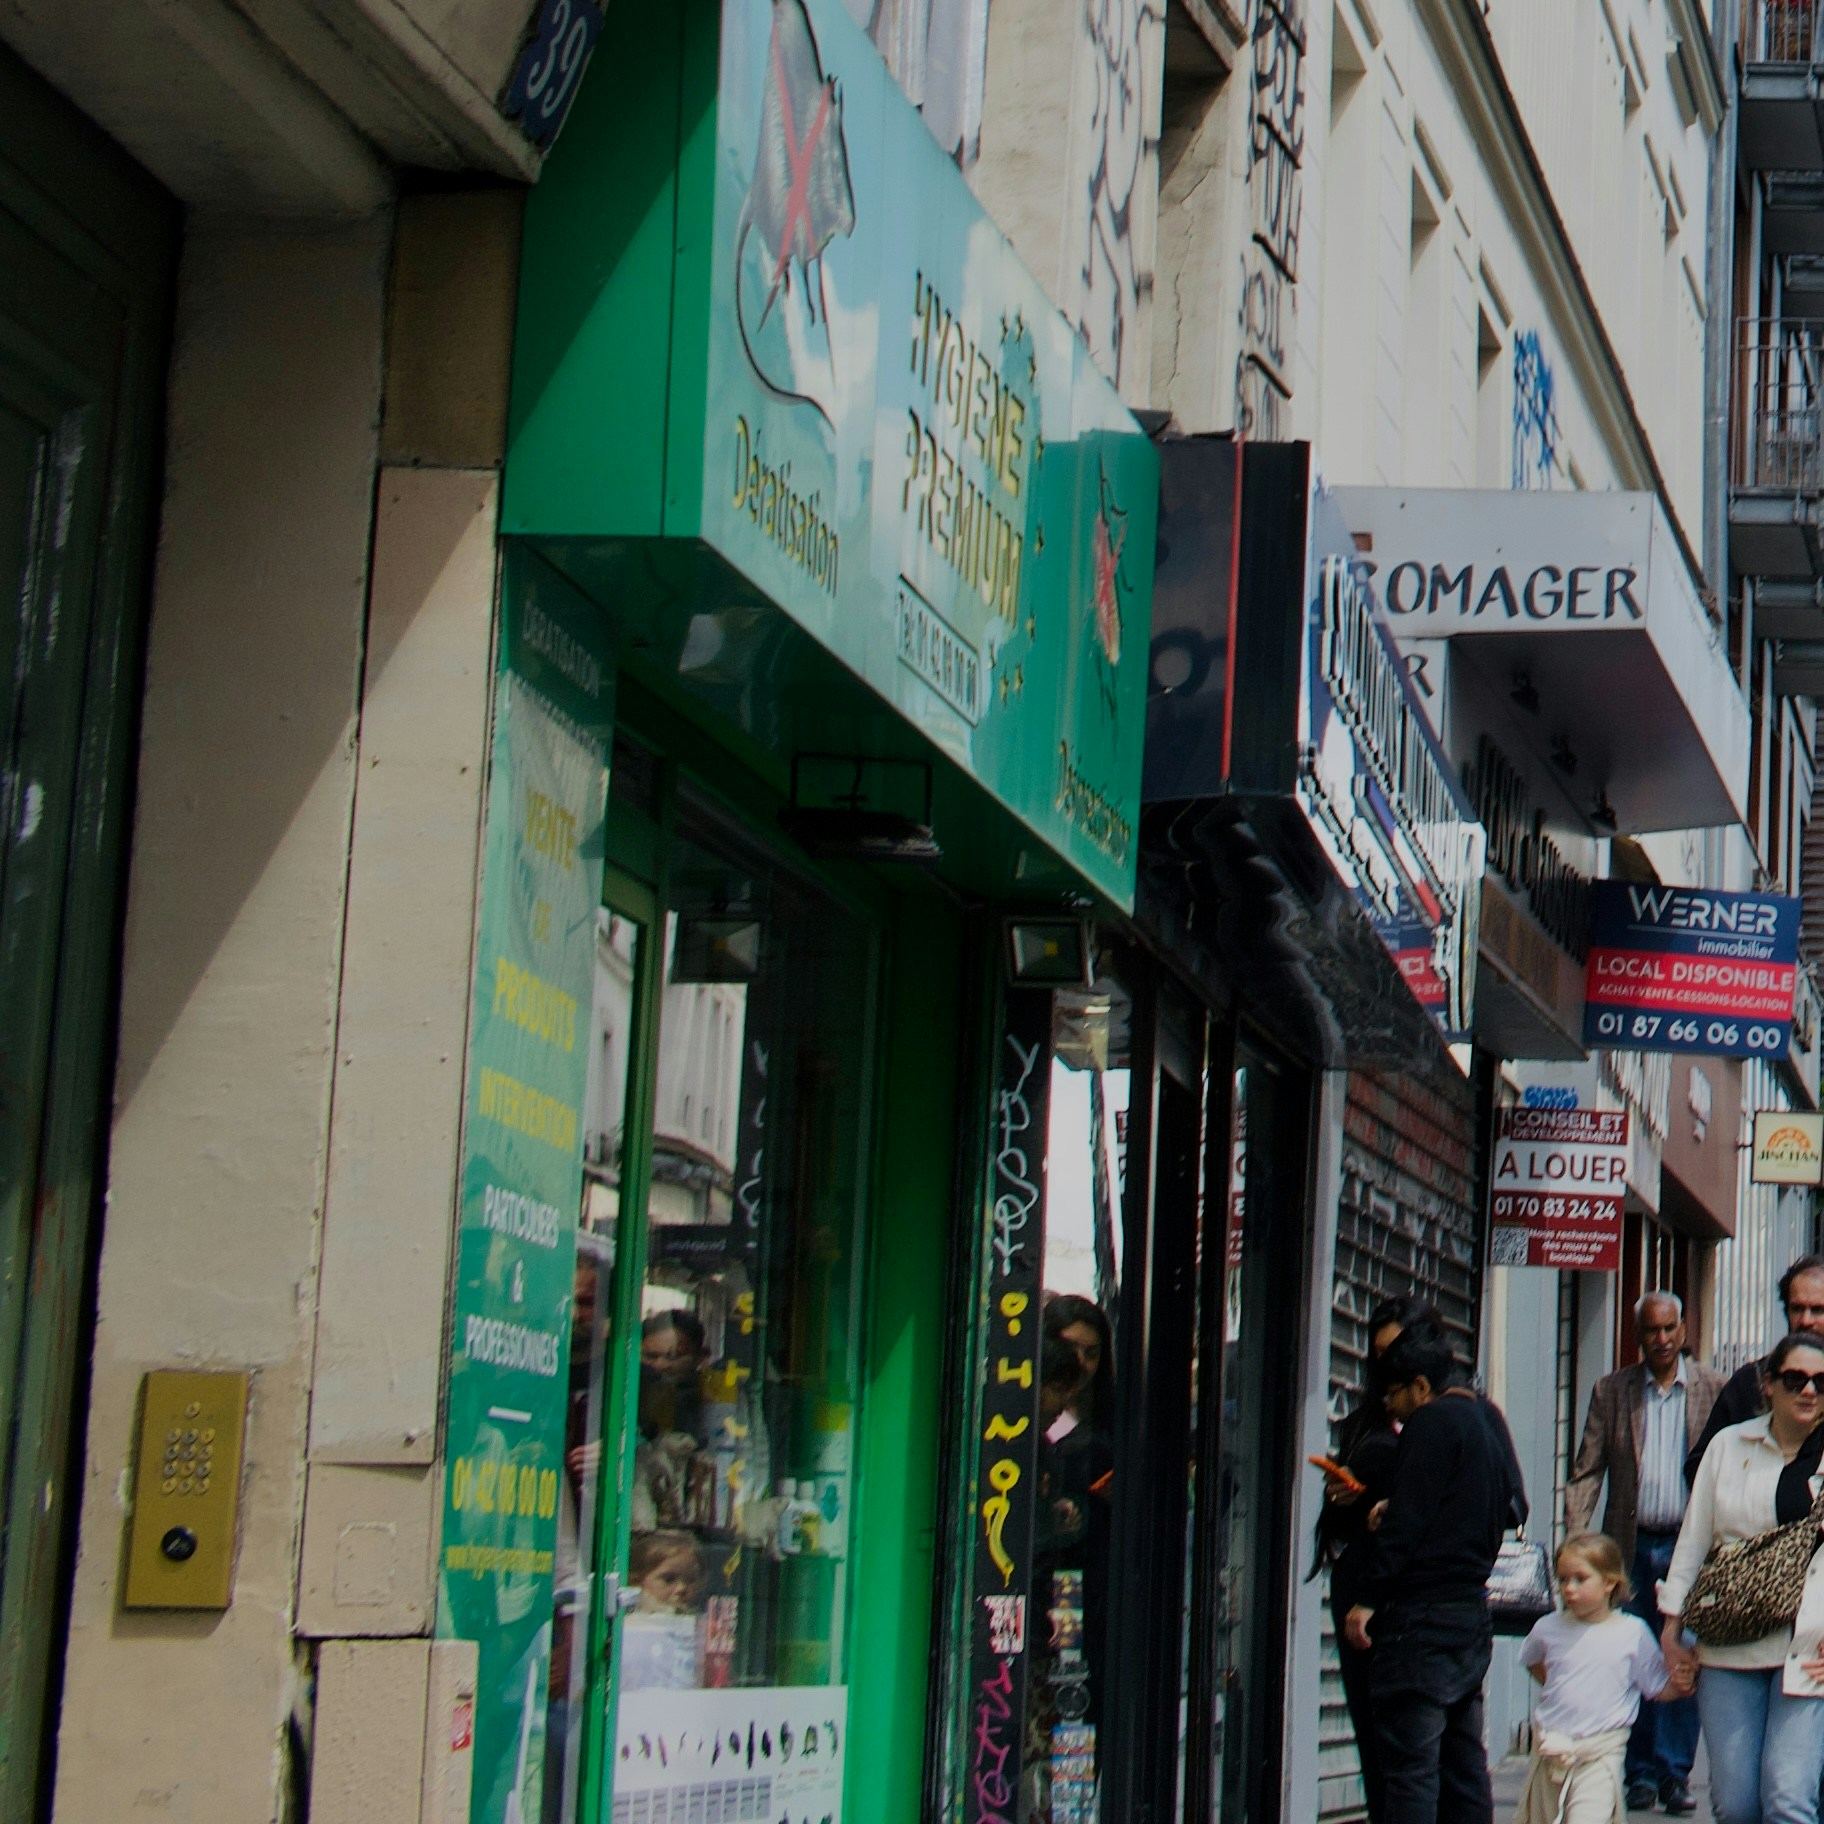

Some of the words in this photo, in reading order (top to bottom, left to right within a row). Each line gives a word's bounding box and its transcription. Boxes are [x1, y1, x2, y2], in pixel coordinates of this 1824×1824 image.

[911, 268, 1024, 498] HYGIENE
[903, 405, 1023, 631] PREMIUM
[526, 784, 577, 871] VENTE
[1628, 885, 1778, 935] WERNER
[1597, 955, 1666, 981] LOCAL
[1672, 962, 1795, 993] DISPONIBLE
[1698, 936, 1775, 960] immobilier
[494, 955, 577, 1053] PRODUITS
[1598, 1012, 1624, 1036] 01
[1632, 1015, 1662, 1039] 87
[1668, 1018, 1699, 1043] 66
[1706, 1021, 1739, 1047] 06
[1747, 1025, 1782, 1050] 00
[479, 1065, 577, 1155] INTERVENTION
[1512, 1126, 1624, 1144] DEVELOPPEMENT
[1513, 1111, 1597, 1130] CONSEIL
[1599, 1114, 1625, 1131] ET
[1498, 1150, 1520, 1180] A
[1528, 1150, 1627, 1185] LOUER
[483, 1183, 561, 1249] PARTICULIERS
[1495, 1196, 1514, 1216] 01
[1516, 1196, 1540, 1217] 70
[1543, 1197, 1566, 1219] 83
[1567, 1198, 1592, 1220] 24
[1593, 1199, 1617, 1222] 24
[464, 1313, 560, 1377] PROFESSIONNELS
[452, 1456, 474, 1511] 01
[476, 1458, 497, 1514] 42
[518, 1465, 537, 1518] 00
[538, 1468, 557, 1520] 00
